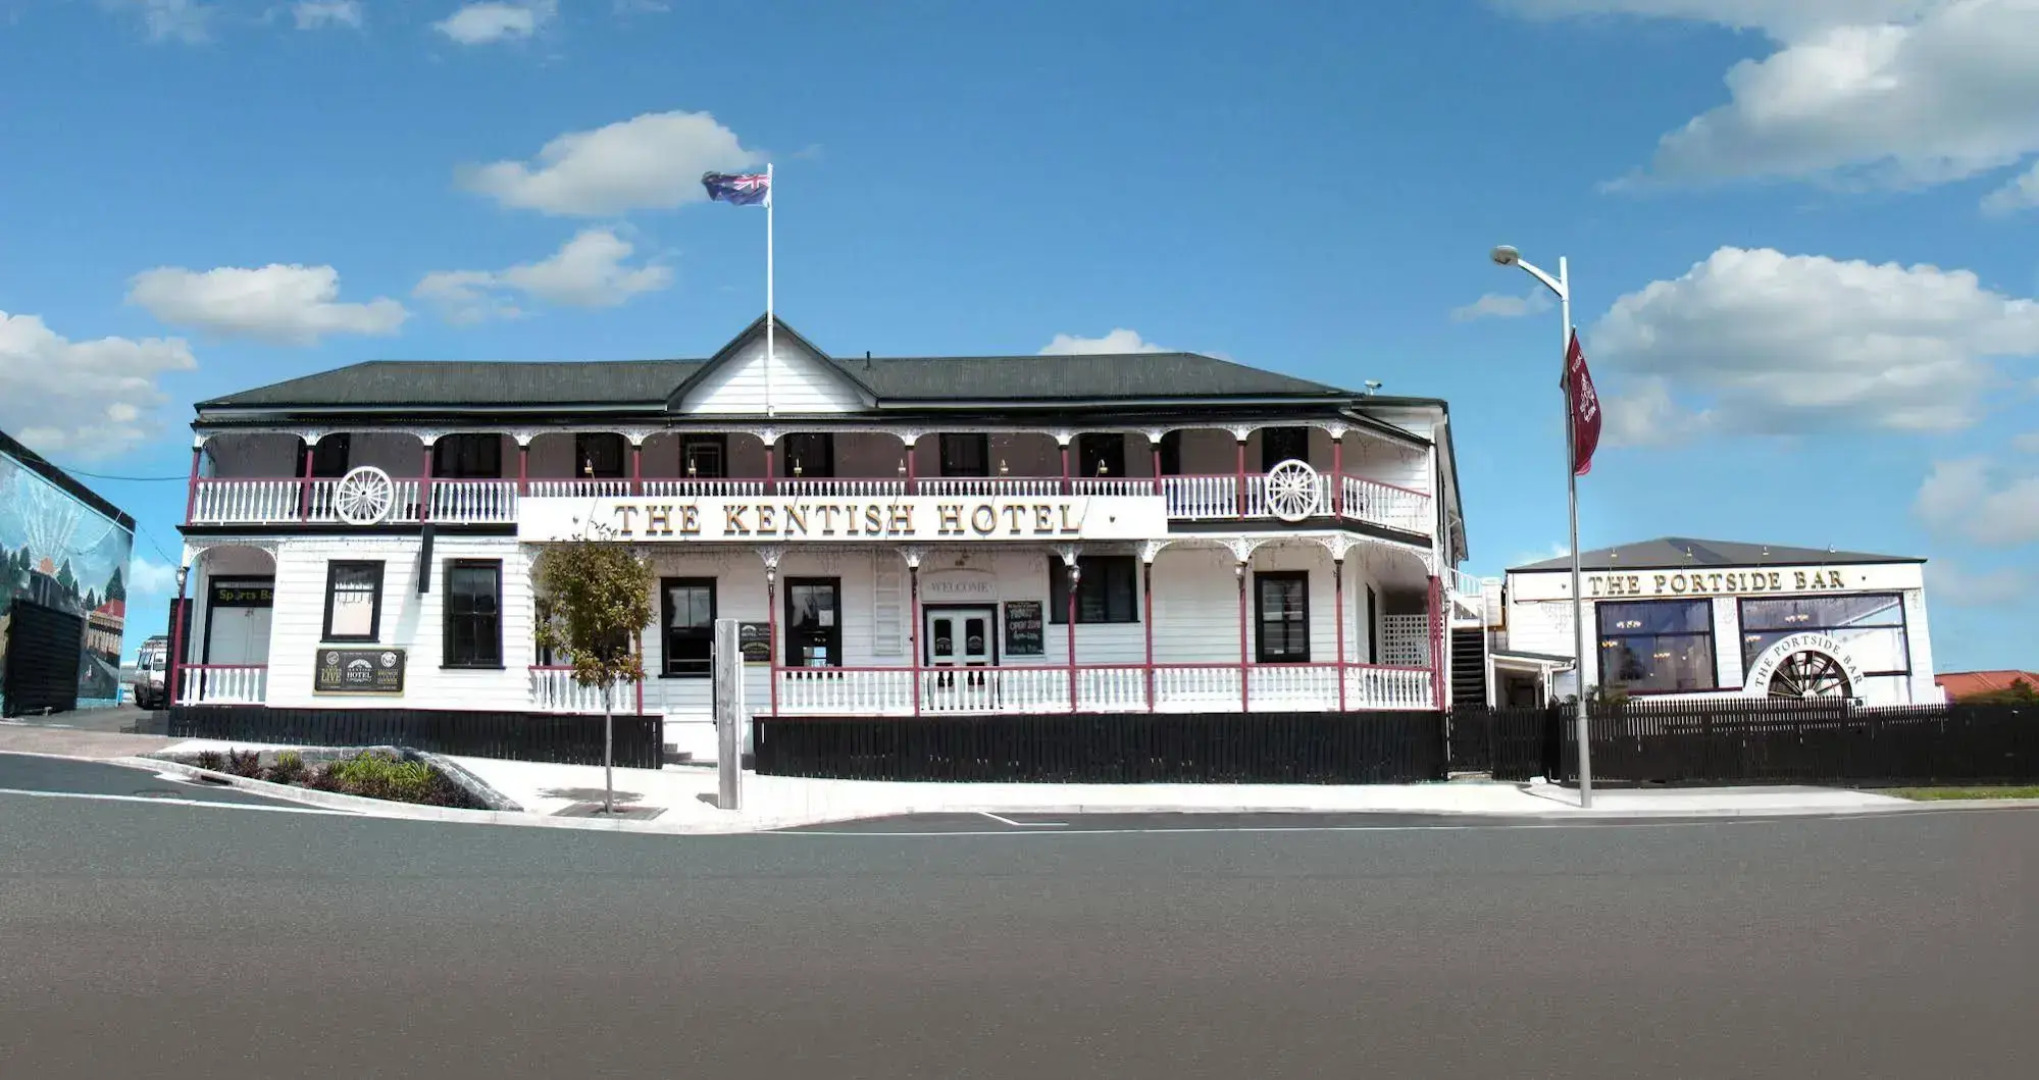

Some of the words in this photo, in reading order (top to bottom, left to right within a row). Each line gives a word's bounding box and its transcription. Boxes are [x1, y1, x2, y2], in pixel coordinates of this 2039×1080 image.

[615, 505, 700, 536] THE
[723, 505, 915, 536] KENTISH
[937, 504, 1080, 535] HOTEL
[931, 582, 988, 593] WELCOME
[1588, 575, 1641, 595] THE
[1653, 571, 1782, 593] PORTSIDE
[1793, 570, 1845, 590] BAR
[1755, 657, 1774, 687] THE
[1774, 635, 1840, 657] PORTSIDE
[1843, 654, 1864, 684] BAR
